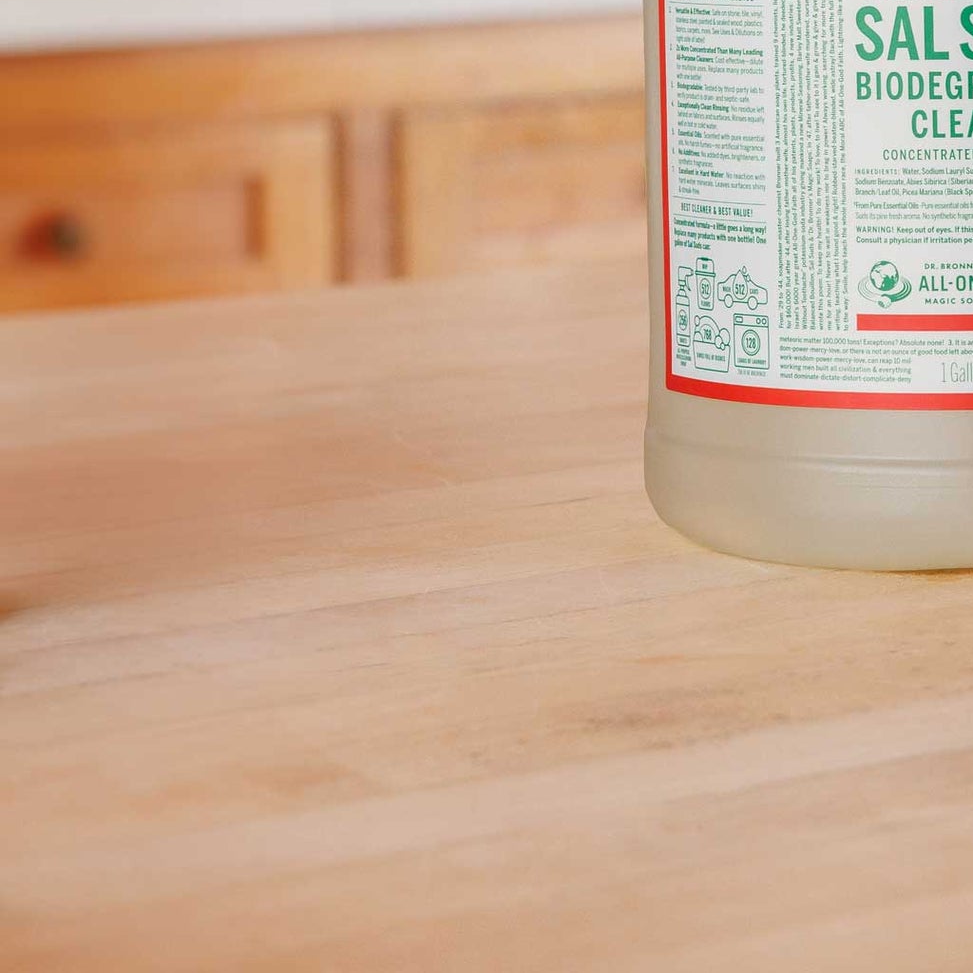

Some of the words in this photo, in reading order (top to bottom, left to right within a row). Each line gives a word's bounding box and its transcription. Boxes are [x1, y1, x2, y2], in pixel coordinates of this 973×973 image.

[856, 6, 949, 60] SAL
[896, 226, 914, 234] Keep
[935, 227, 952, 235] eyes.
[856, 236, 882, 244] Consult
[889, 237, 922, 245] physician
[930, 236, 963, 244] irritation
[735, 284, 745, 295] 512
[925, 297, 956, 305] MAGIC
[746, 338, 756, 349] 128
[942, 362, 947, 384] 1
